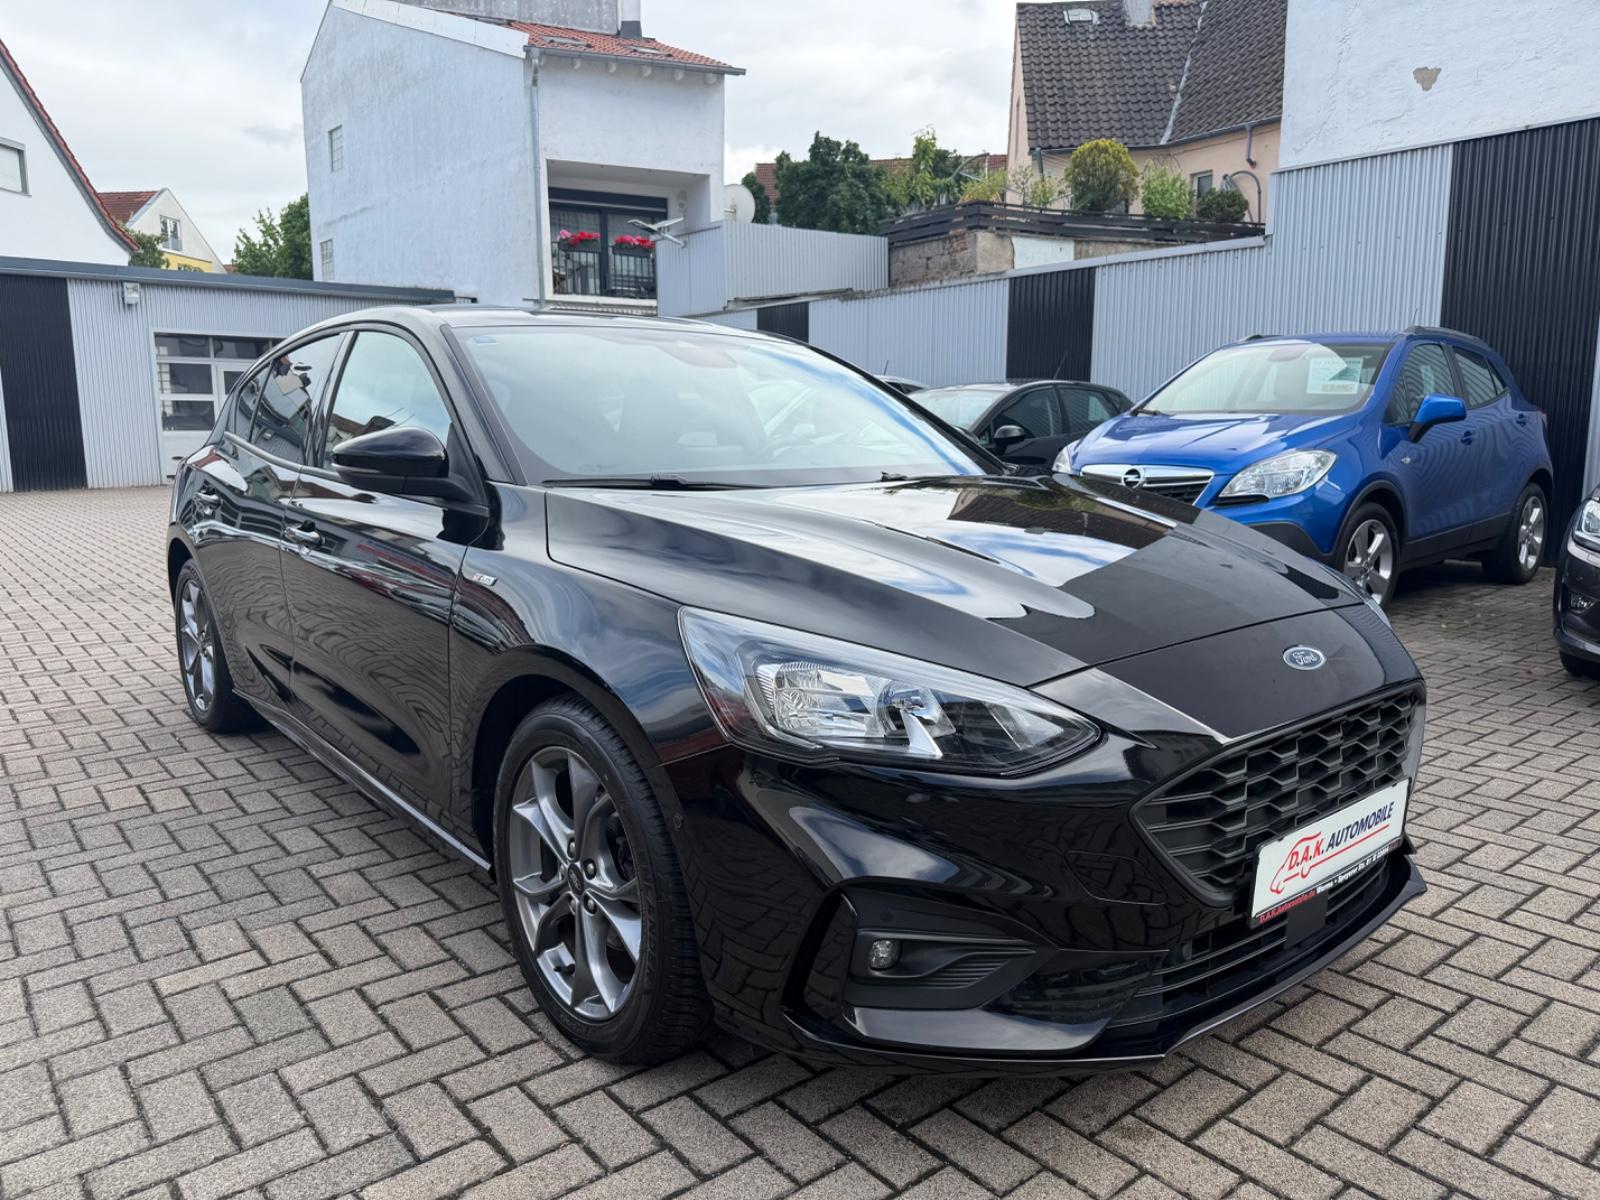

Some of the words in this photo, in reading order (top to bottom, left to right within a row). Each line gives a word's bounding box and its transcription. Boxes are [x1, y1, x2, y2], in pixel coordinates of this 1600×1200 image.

[1293, 651, 1317, 665] Ford
[1288, 838, 1324, 870] D.A.K.
[1326, 801, 1395, 852] AUTOMOBILE
